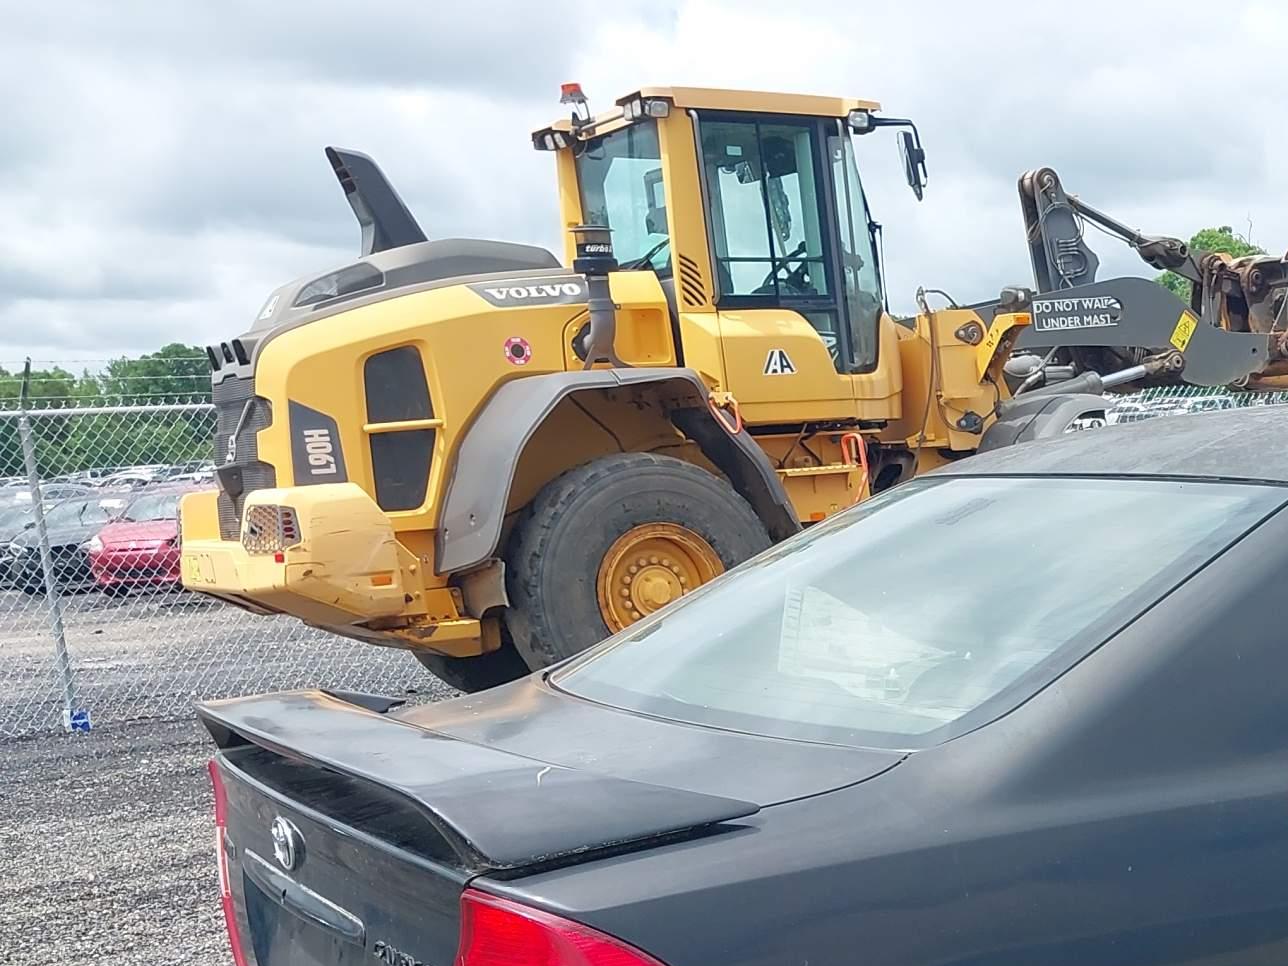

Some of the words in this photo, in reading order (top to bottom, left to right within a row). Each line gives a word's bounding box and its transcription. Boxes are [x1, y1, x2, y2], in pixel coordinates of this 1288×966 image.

[484, 283, 581, 300] VOLVO
[1034, 302, 1051, 314] DO
[1054, 300, 1081, 312] NOT
[1042, 316, 1081, 329] UNDER
[303, 429, 337, 475] L90H
